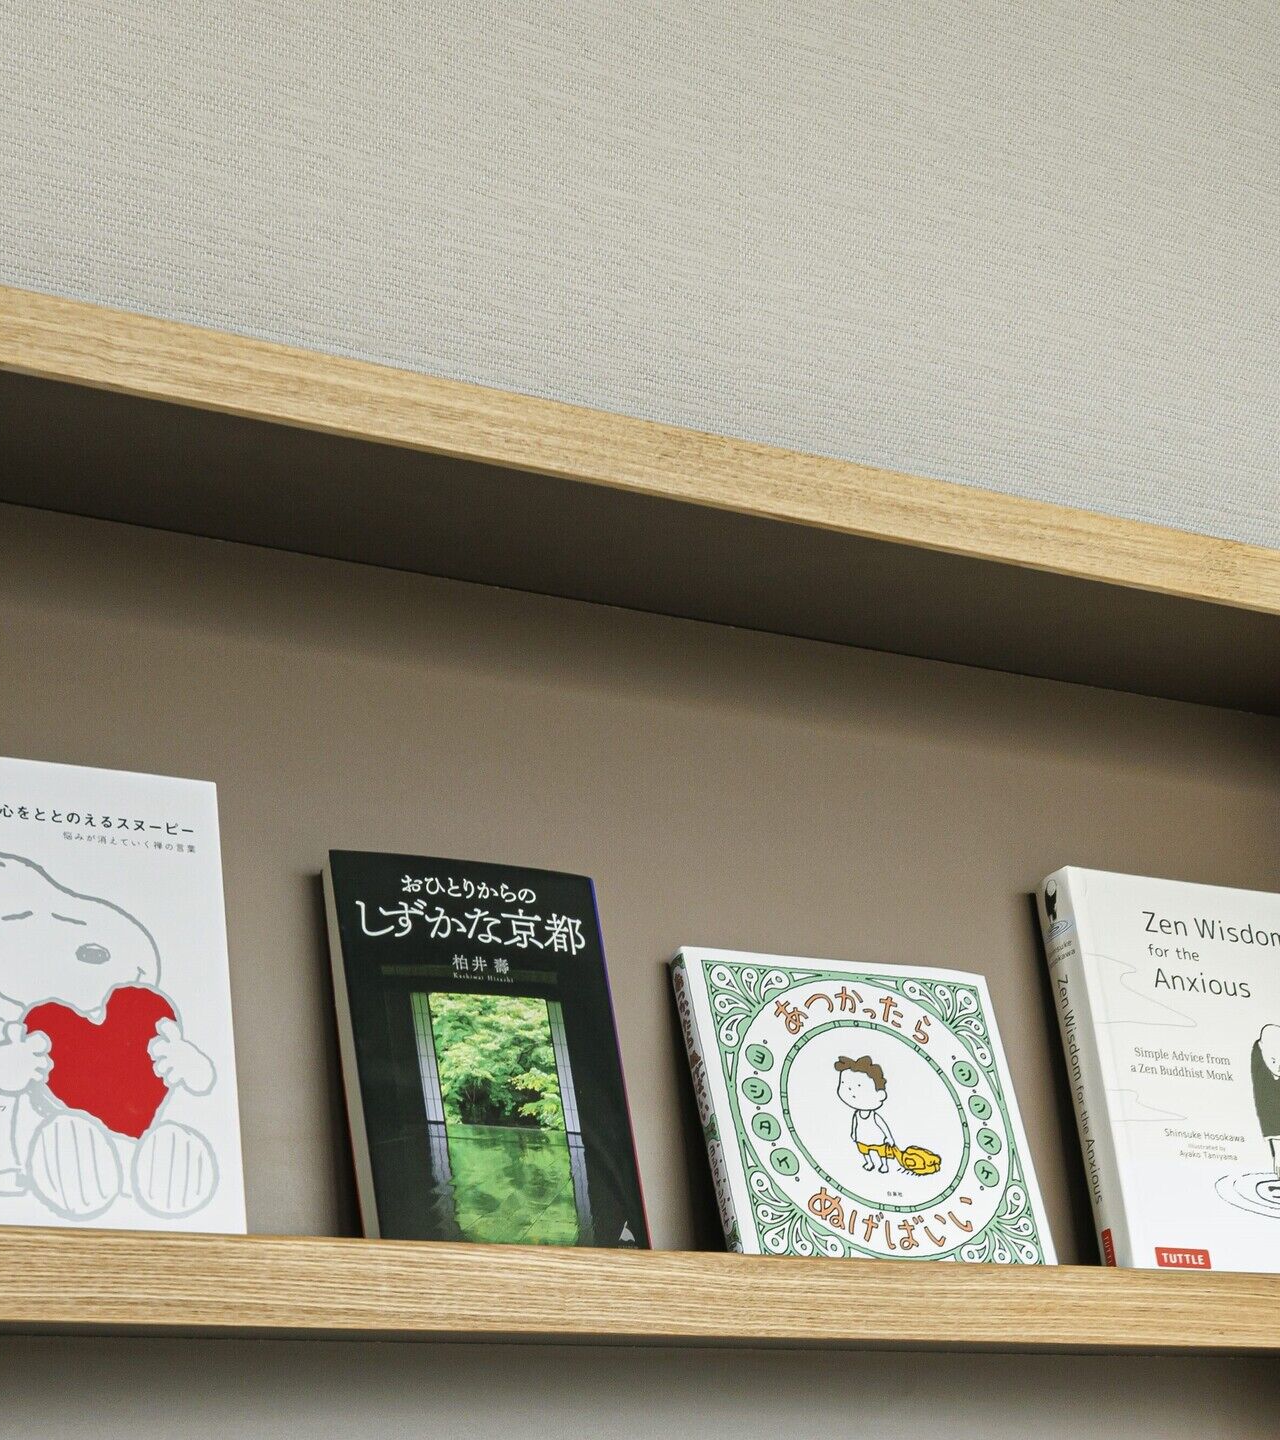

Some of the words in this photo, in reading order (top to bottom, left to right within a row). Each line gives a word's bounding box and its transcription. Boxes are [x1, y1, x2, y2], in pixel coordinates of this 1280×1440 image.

[400, 874, 537, 904] おひとりからの
[355, 898, 586, 956] しずかな京都
[1142, 910, 1188, 937] Zen
[1148, 943, 1170, 957] for
[1175, 947, 1200, 961] the
[1057, 974, 1070, 1006] Zen
[1154, 967, 1252, 999] Anxious
[773, 986, 932, 1045] あつかったら
[1064, 1008, 1082, 1083] Wisdom
[1133, 1046, 1169, 1062] Simple
[1172, 1050, 1205, 1064] Advice
[1206, 1053, 1231, 1066] from
[1130, 1064, 1137, 1073] a
[1138, 1063, 1158, 1075] Zen
[1159, 1065, 1205, 1079] Buddhist
[1206, 1069, 1234, 1082] Monk
[1075, 1084, 1086, 1105] for
[1080, 1104, 1091, 1135] the
[1164, 1128, 1202, 1140] Shinsuke
[1203, 1131, 1246, 1143] Hosokawa
[1085, 1138, 1103, 1205] Anxious
[807, 1186, 973, 1250] ぬげばいい
[1161, 1252, 1206, 1266] TUTTLE
